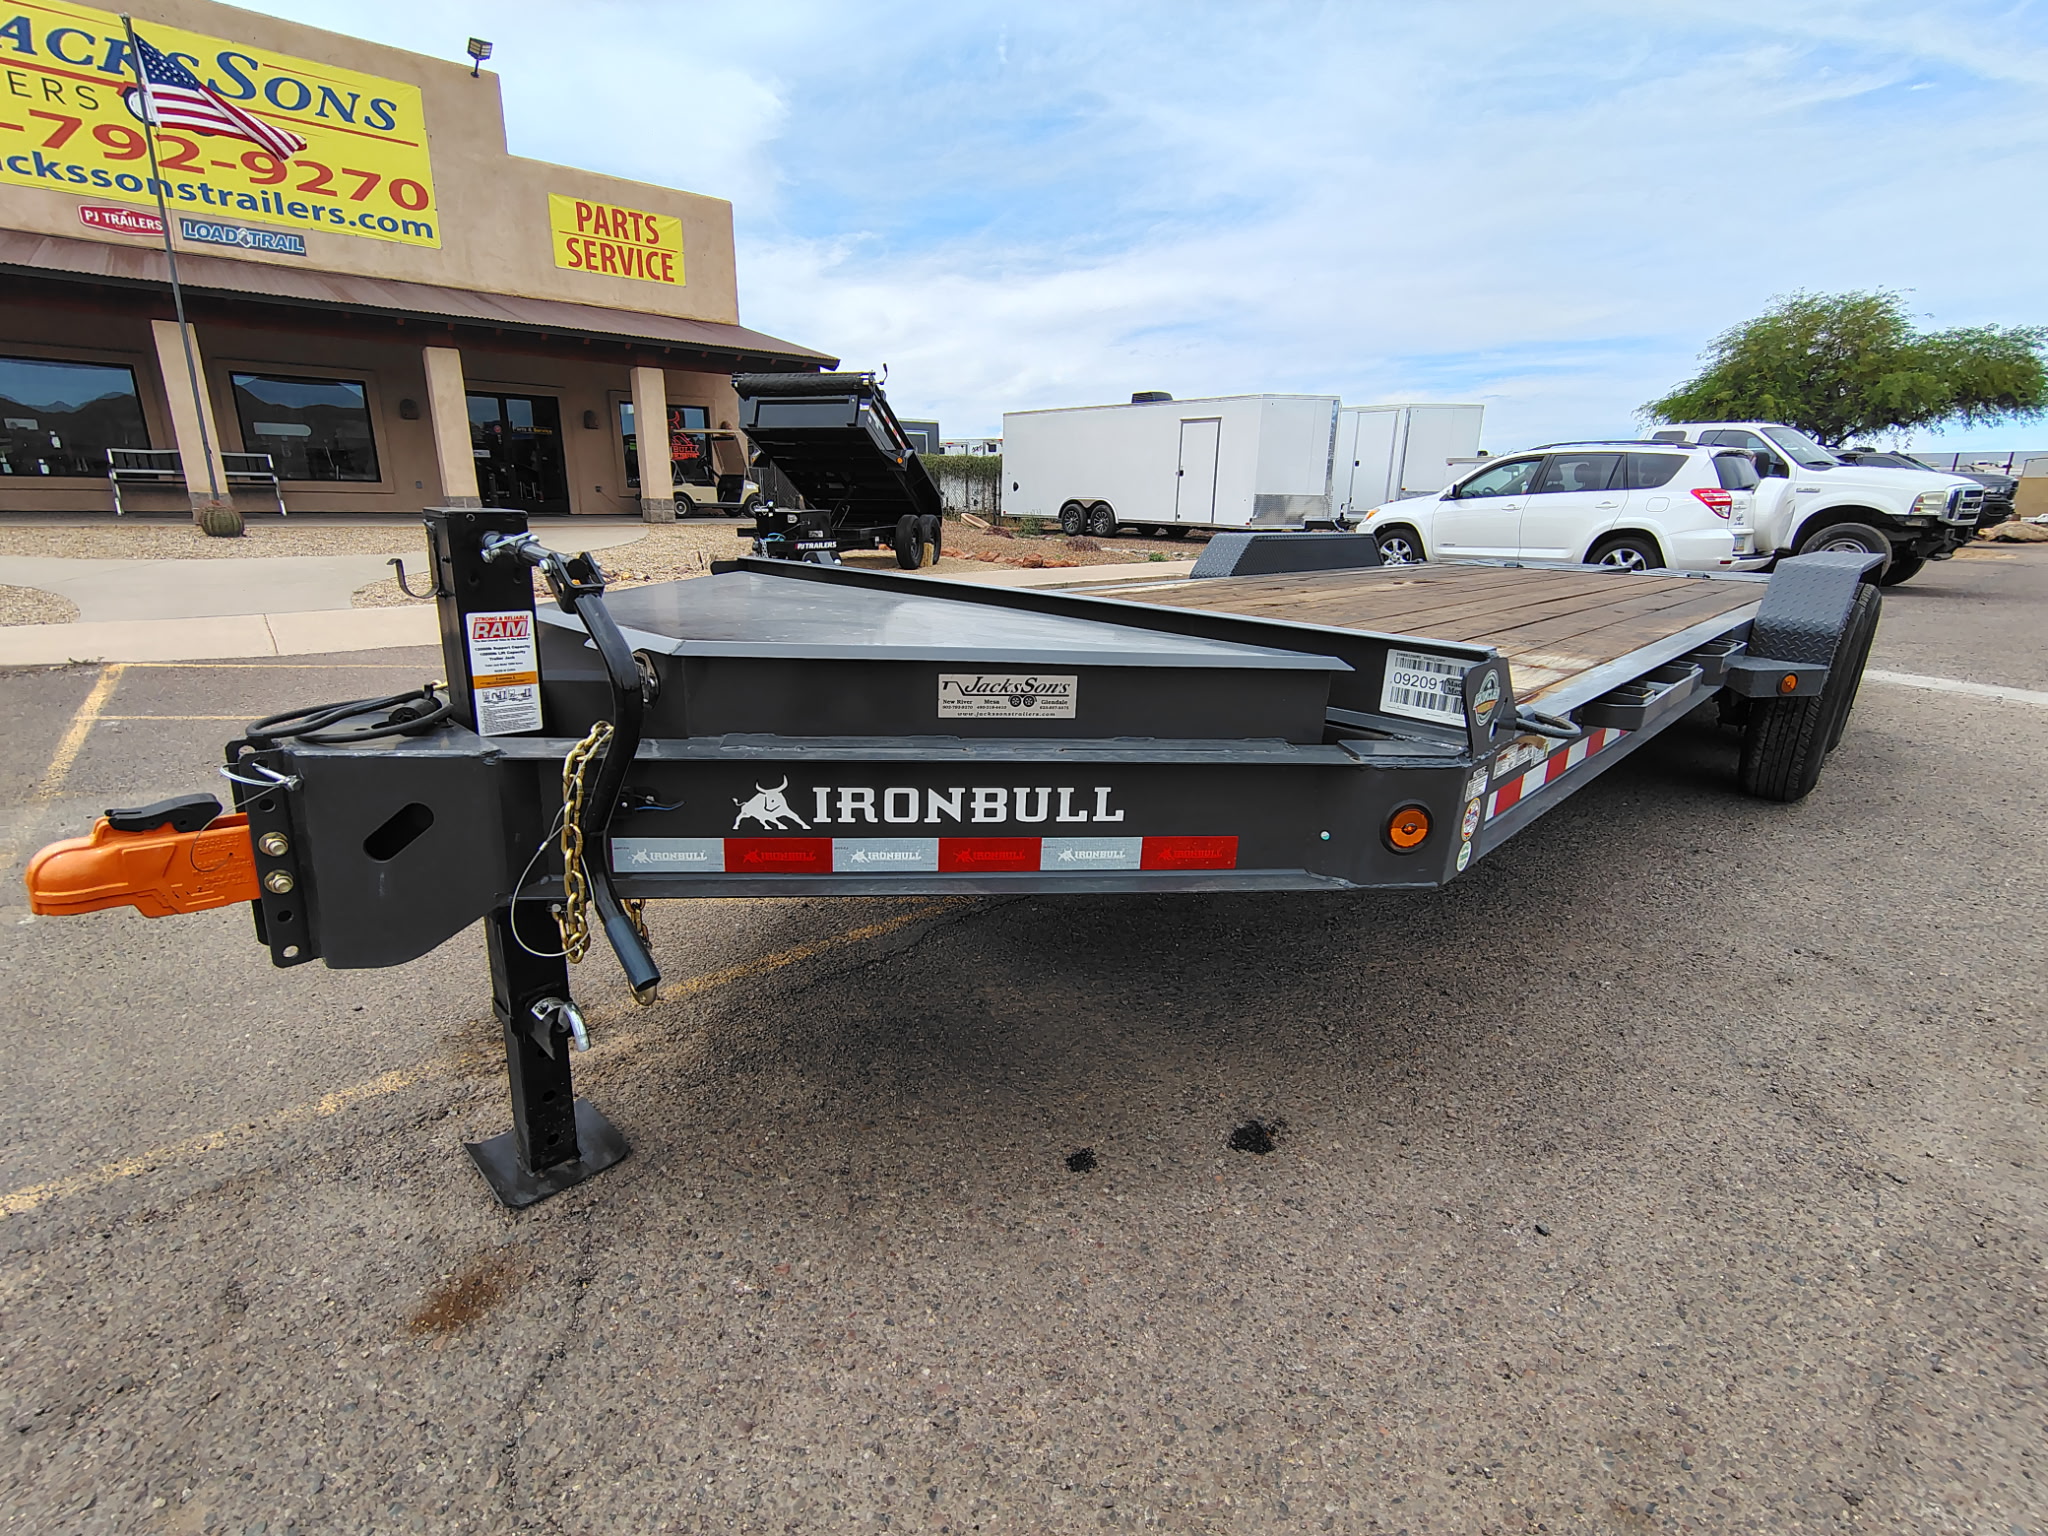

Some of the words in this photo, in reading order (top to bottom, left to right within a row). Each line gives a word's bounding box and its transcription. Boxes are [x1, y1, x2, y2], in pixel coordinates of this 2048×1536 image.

[85, 210, 100, 223] PJ
[102, 212, 164, 232] TRAILERS
[575, 201, 660, 245] PARTS
[183, 221, 238, 244] LOAD
[250, 231, 305, 253] TRAIL
[566, 237, 675, 283] SERVICE
[806, 541, 837, 549] TRAILERS
[473, 621, 527, 639] RAM
[812, 786, 1125, 823] IRONBULL
[649, 851, 708, 862] IRONBULL
[868, 850, 922, 861] IRONBULL
[1074, 850, 1126, 860] IRONBULL
